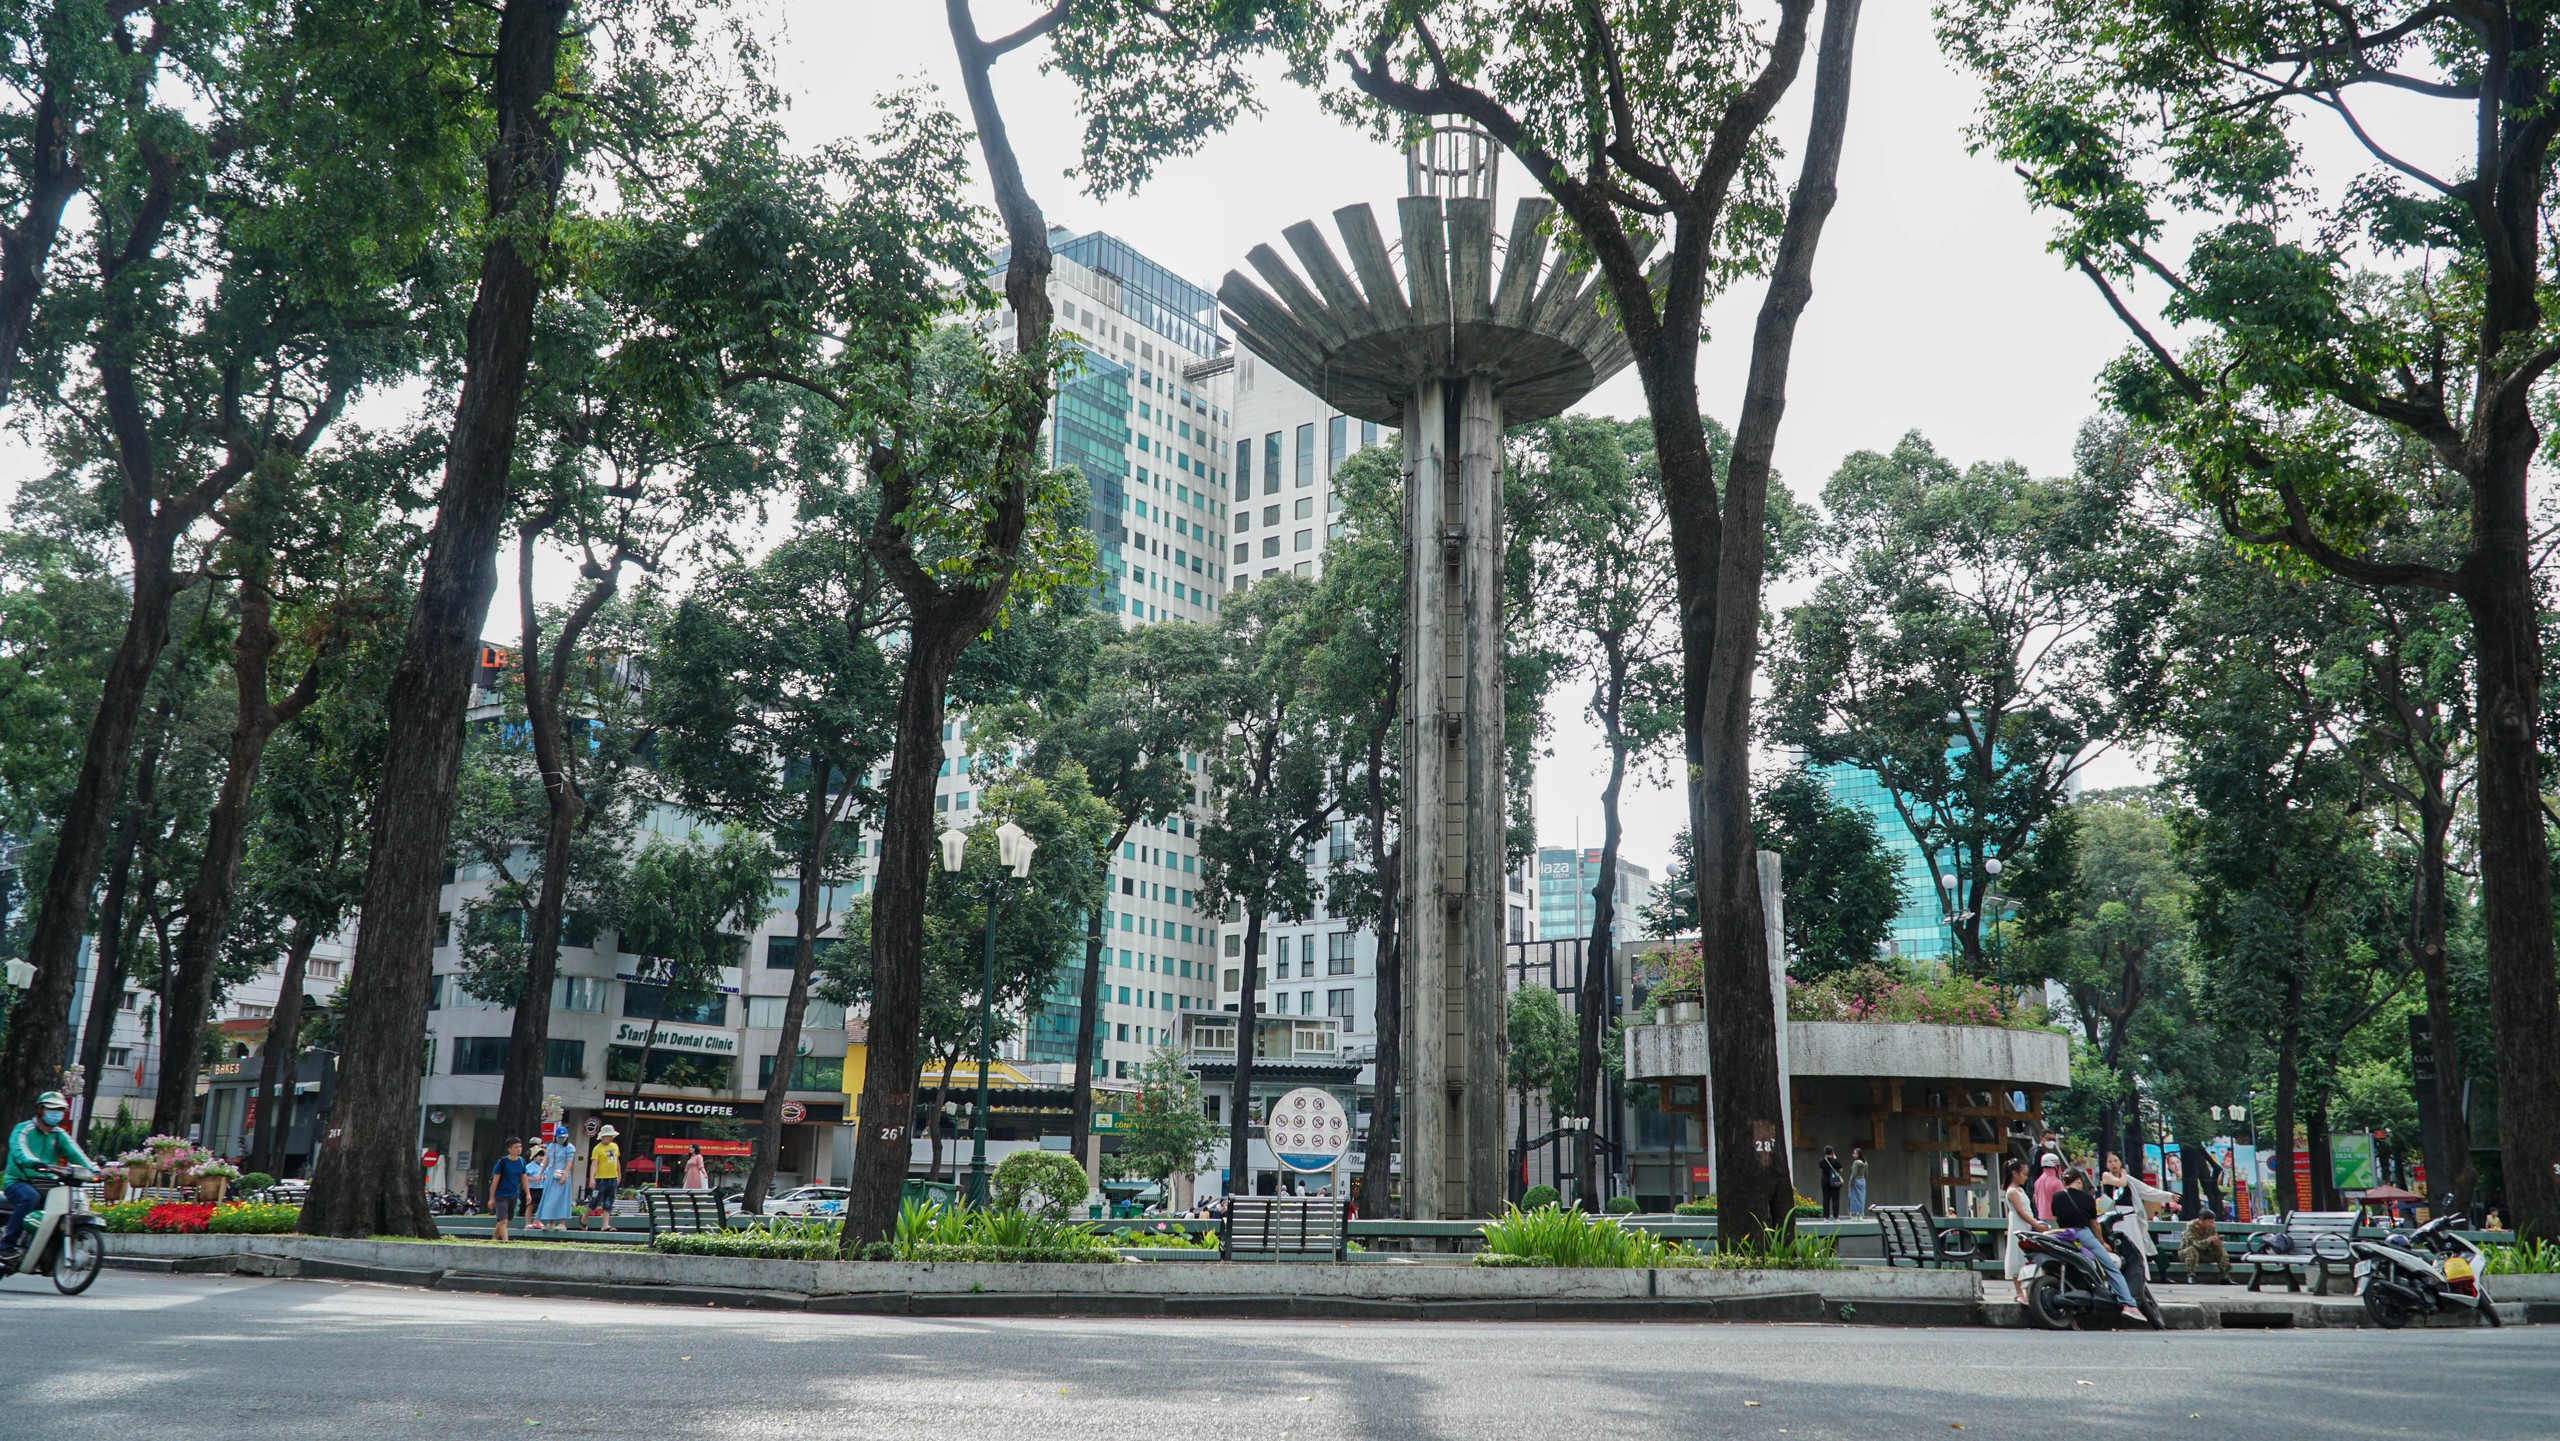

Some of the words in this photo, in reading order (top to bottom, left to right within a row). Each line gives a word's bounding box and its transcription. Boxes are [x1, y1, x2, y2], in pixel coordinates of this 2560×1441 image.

[1538, 861, 1570, 874] laza
[617, 1023, 669, 1046] Starlght
[670, 1031, 704, 1048] Dental
[705, 1036, 734, 1051] Clinic
[685, 1104, 733, 1116] COFFEE
